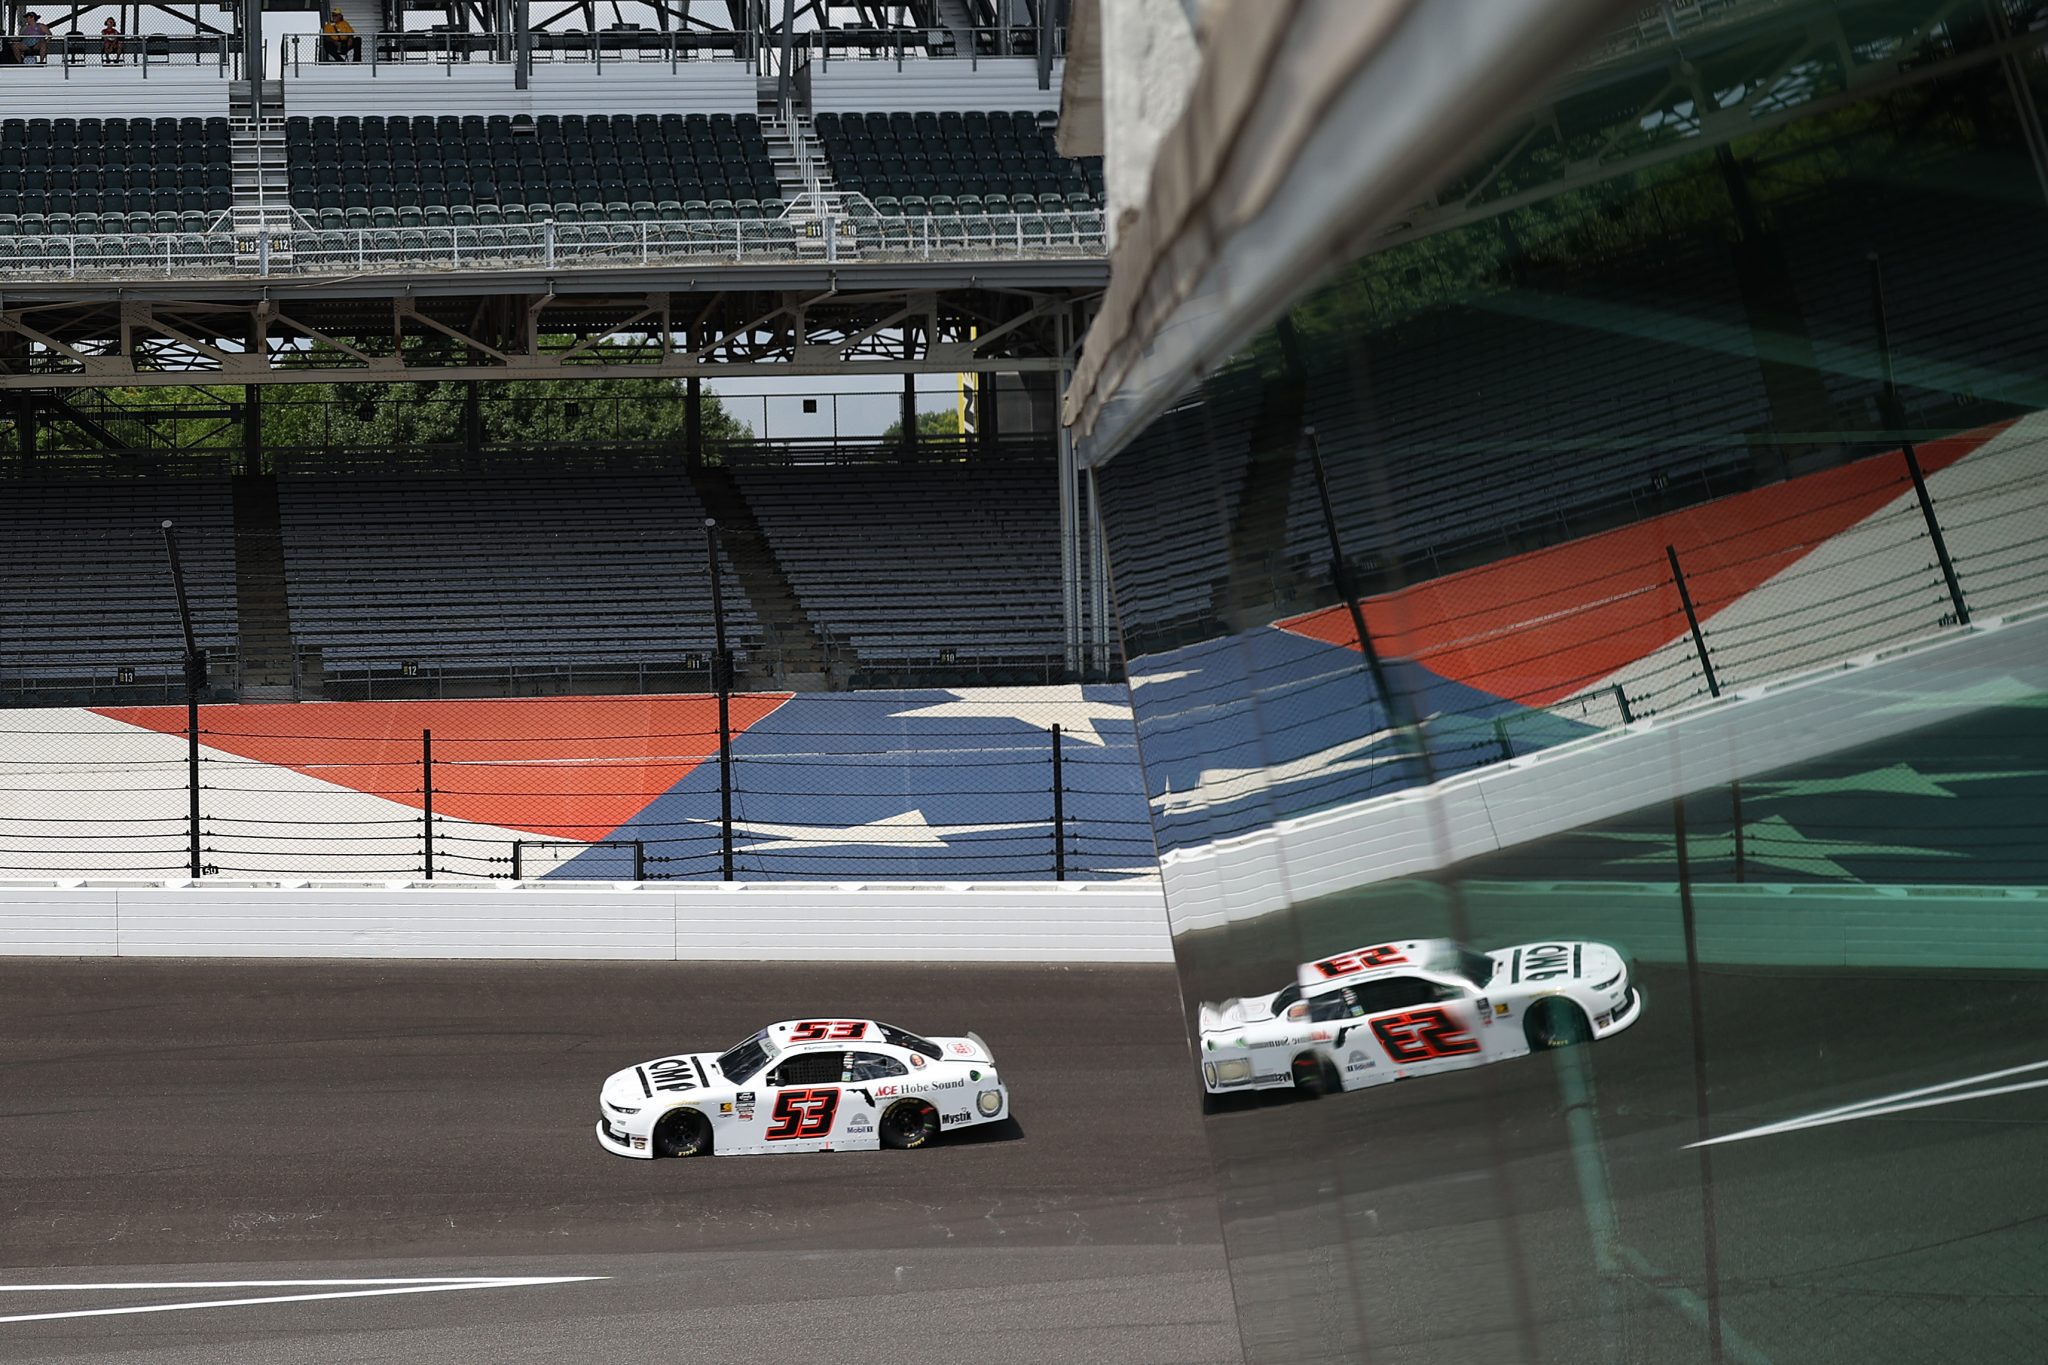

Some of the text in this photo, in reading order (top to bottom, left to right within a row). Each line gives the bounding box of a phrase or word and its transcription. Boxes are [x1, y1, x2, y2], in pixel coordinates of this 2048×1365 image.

[812, 225, 821, 236] 11
[847, 224, 857, 236] 10
[245, 241, 255, 252] 13
[279, 240, 289, 250] 12
[408, 665, 417, 676] 12
[124, 672, 133, 682] 13
[789, 1021, 868, 1042] 53
[648, 1059, 697, 1092] CMP
[875, 1077, 965, 1096] ACE Hobe Sound
[765, 1087, 841, 1141] 53
[941, 1111, 972, 1125] Mystik
[847, 1126, 865, 1134] Mobil
